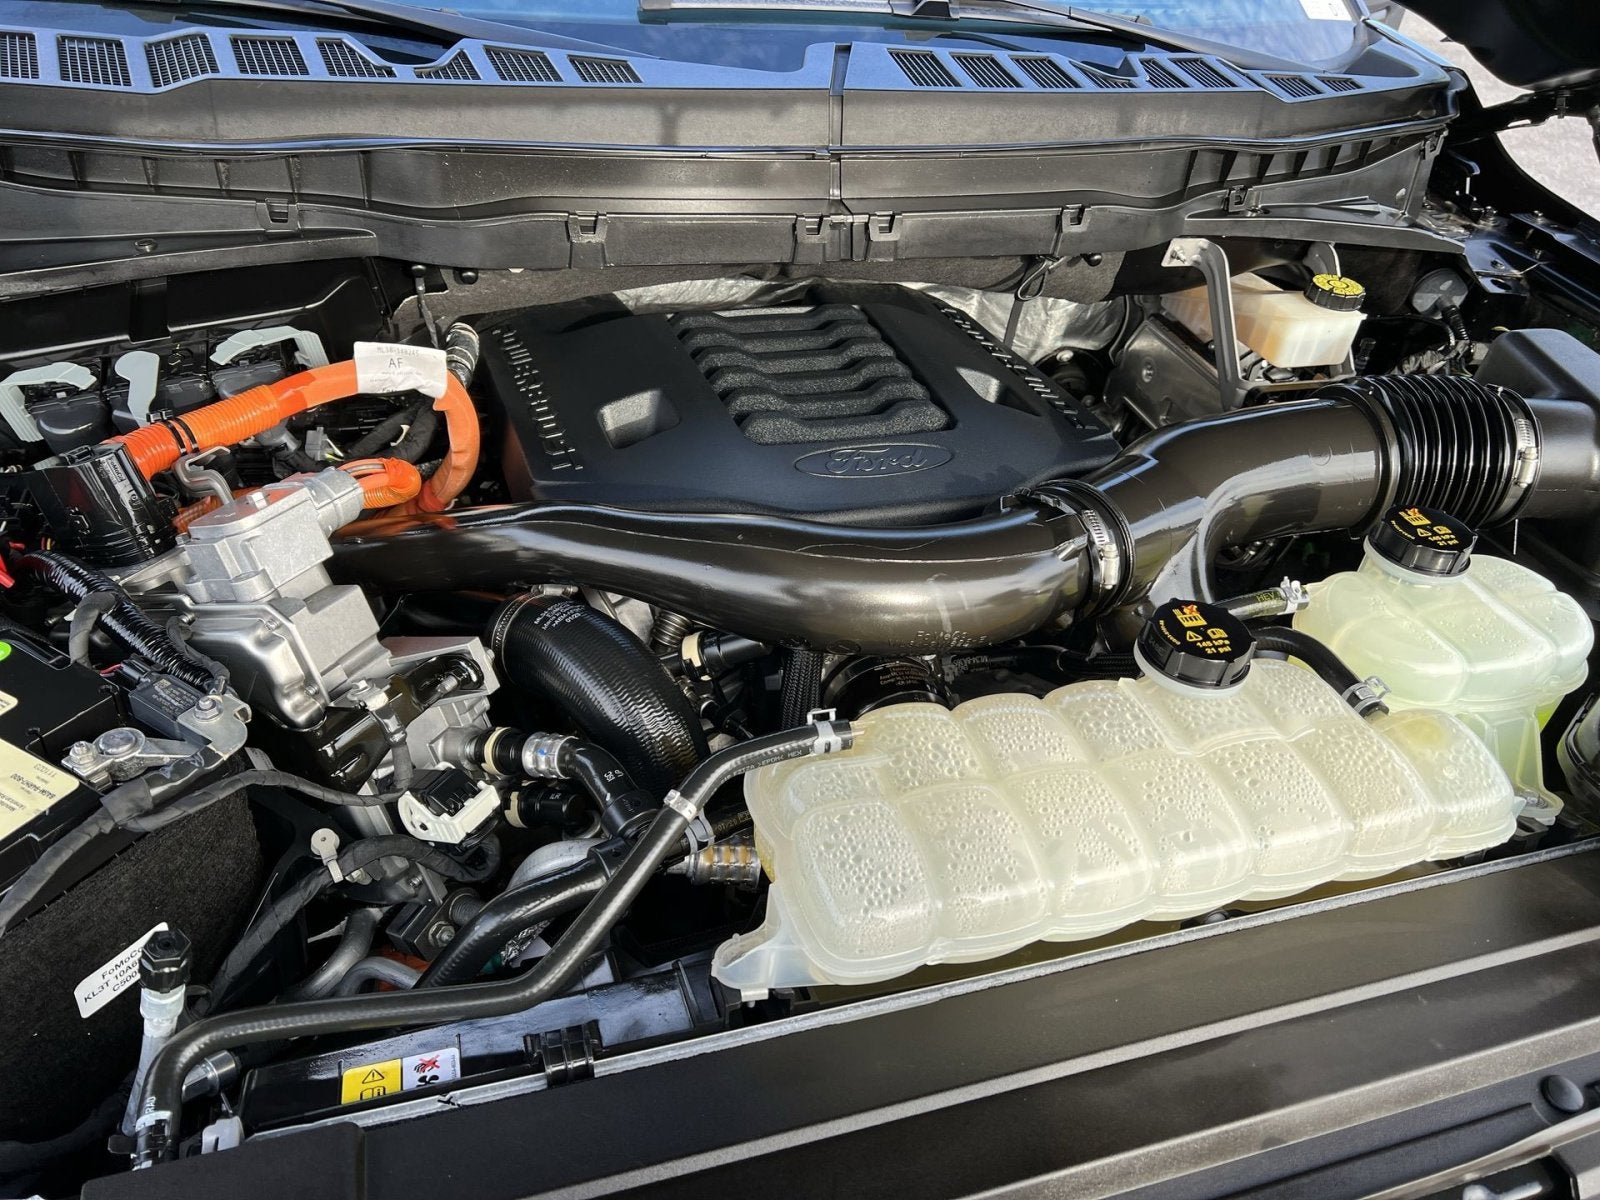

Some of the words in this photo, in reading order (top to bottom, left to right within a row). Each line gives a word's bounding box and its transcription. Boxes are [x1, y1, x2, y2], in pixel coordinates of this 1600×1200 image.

[388, 357, 404, 369] AF
[1218, 645, 1232, 654] psi
[101, 946, 144, 980] FoMoCo
[83, 979, 112, 1003] KL3T
